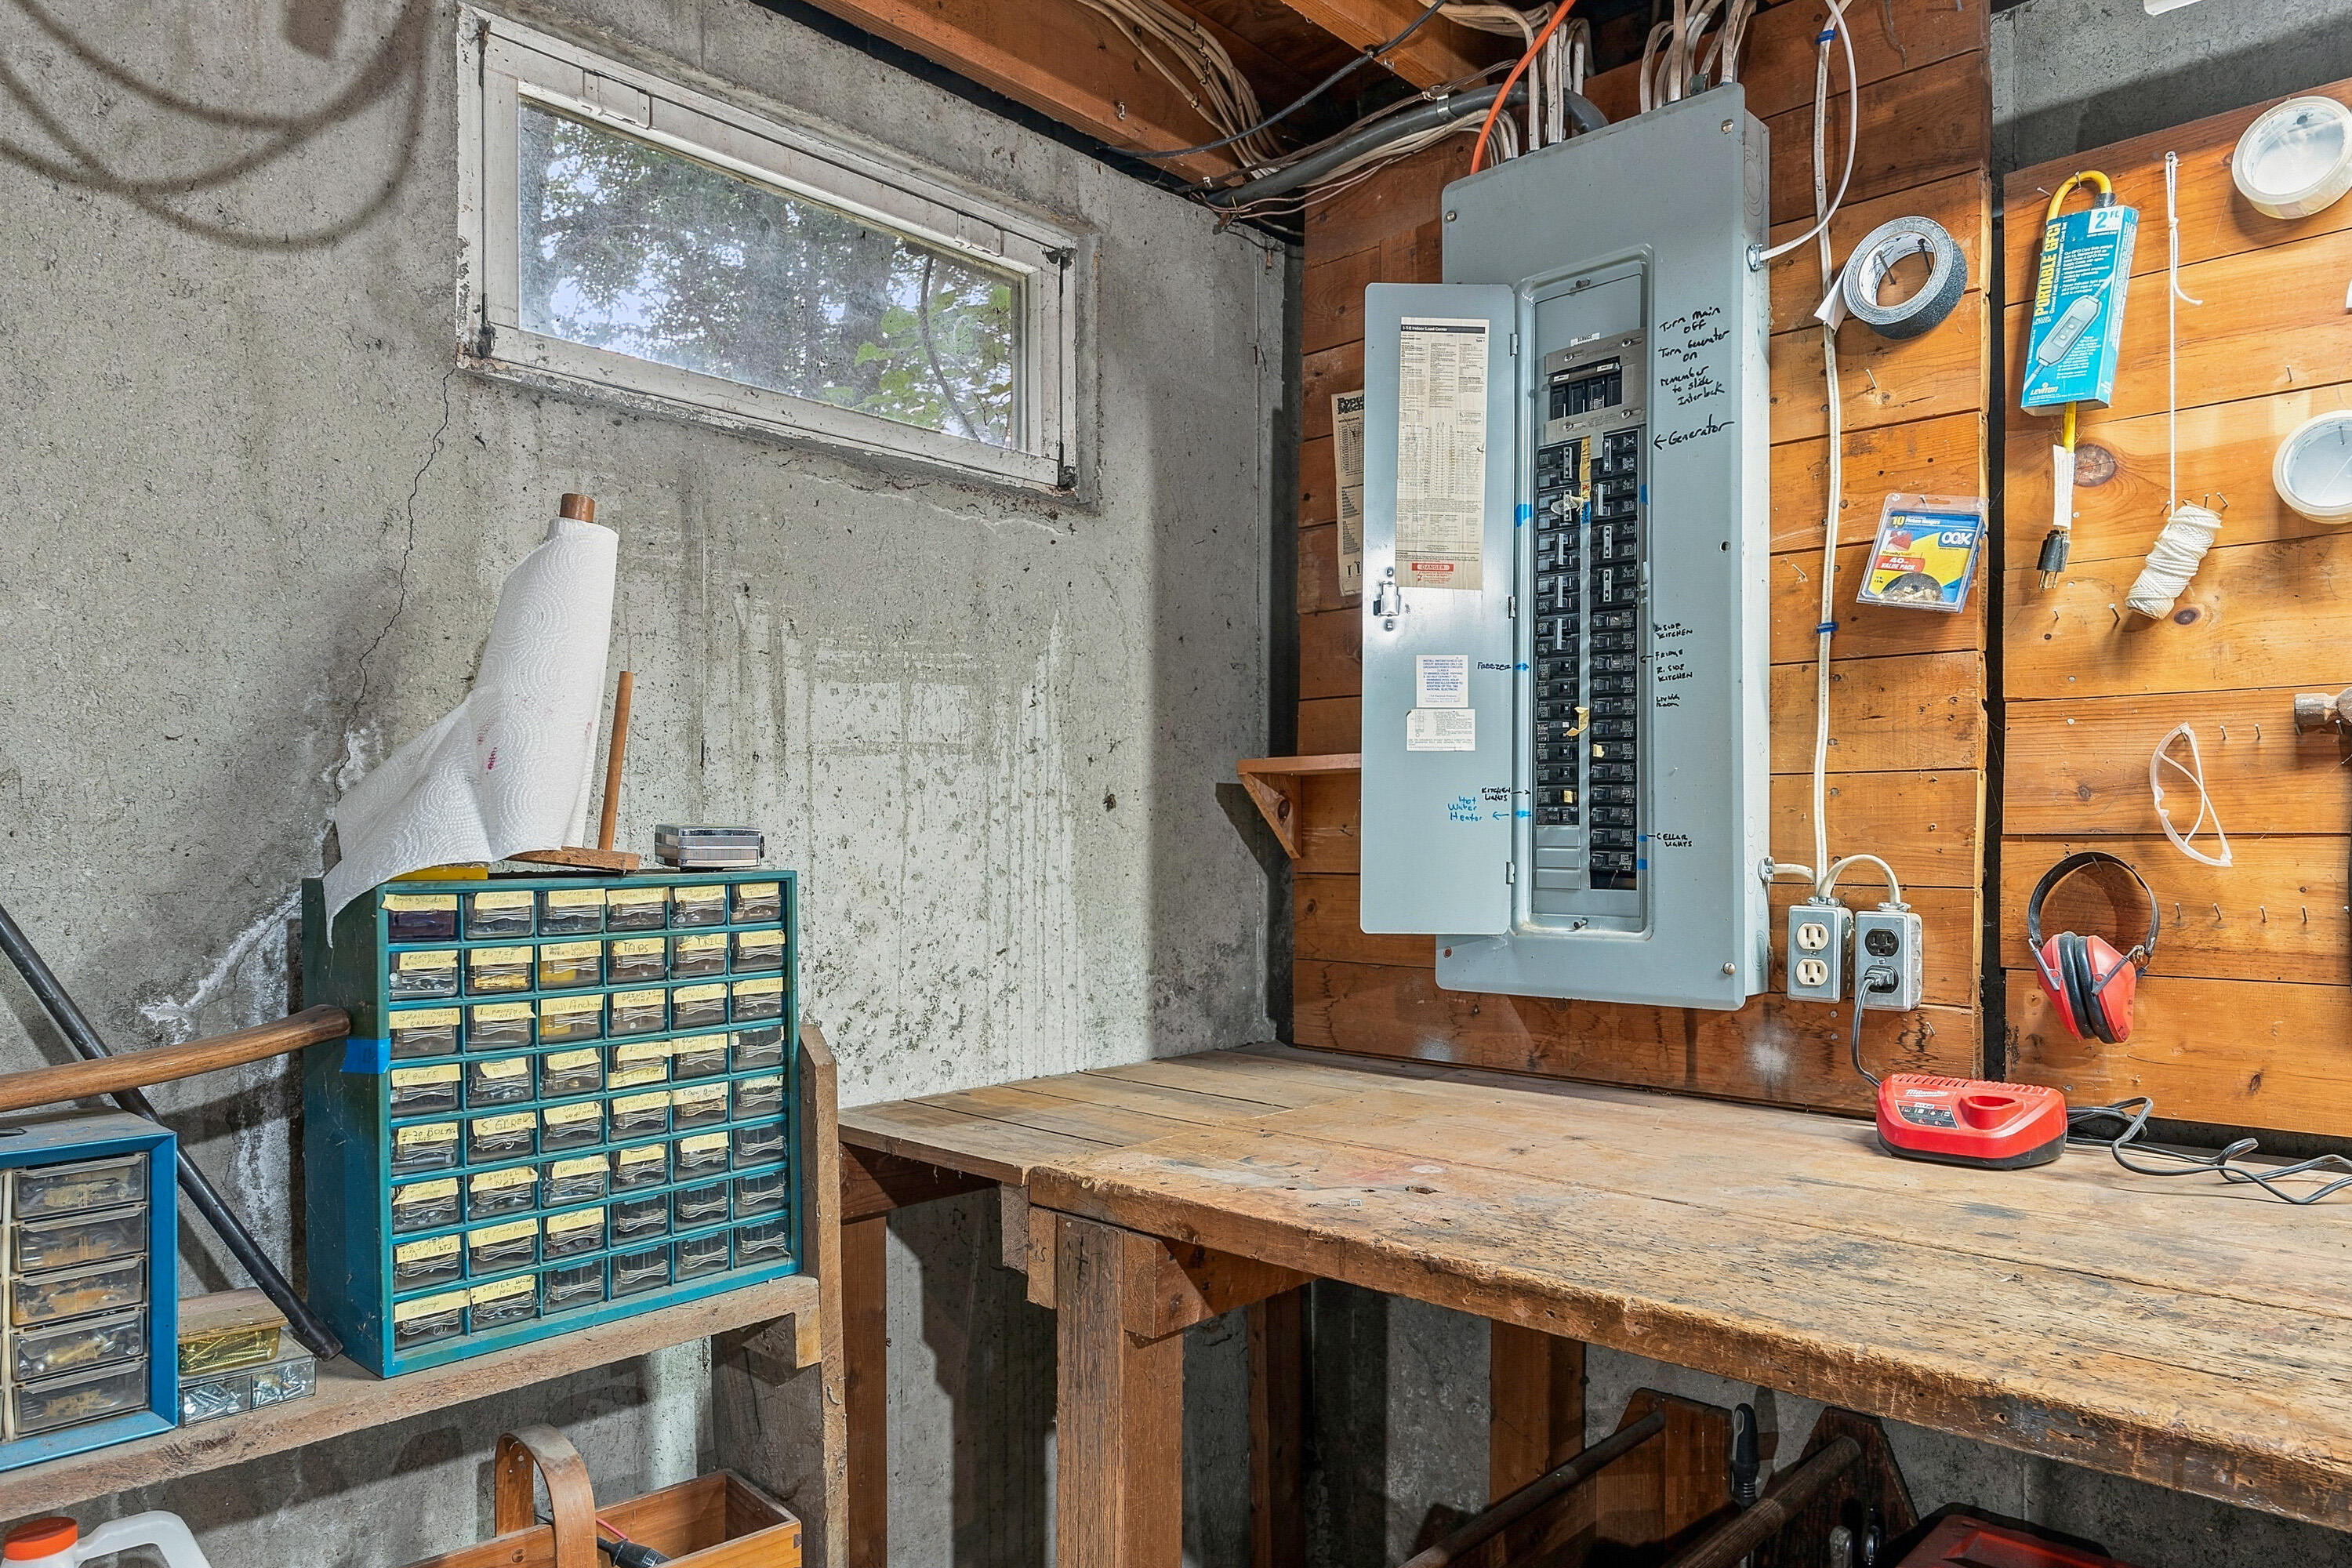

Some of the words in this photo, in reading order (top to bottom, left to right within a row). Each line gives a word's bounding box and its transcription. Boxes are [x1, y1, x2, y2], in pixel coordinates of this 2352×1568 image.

[2095, 212, 2107, 229] 2
[2044, 223, 2062, 252] GFCI
[2034, 253, 2057, 317] PORTABLE
[1659, 318, 1686, 332] Turn
[1658, 347, 1682, 358] Turn
[1688, 376, 1714, 390] slide
[1668, 414, 1735, 445] Generator
[1892, 516, 1905, 526] 10
[1941, 532, 1973, 545] OOK
[1656, 629, 1693, 639] KITCHEN
[1657, 672, 1693, 682] KITCHEN
[1458, 796, 1477, 805] Hot
[1447, 803, 1477, 811] Water
[1450, 811, 1483, 822] Heater
